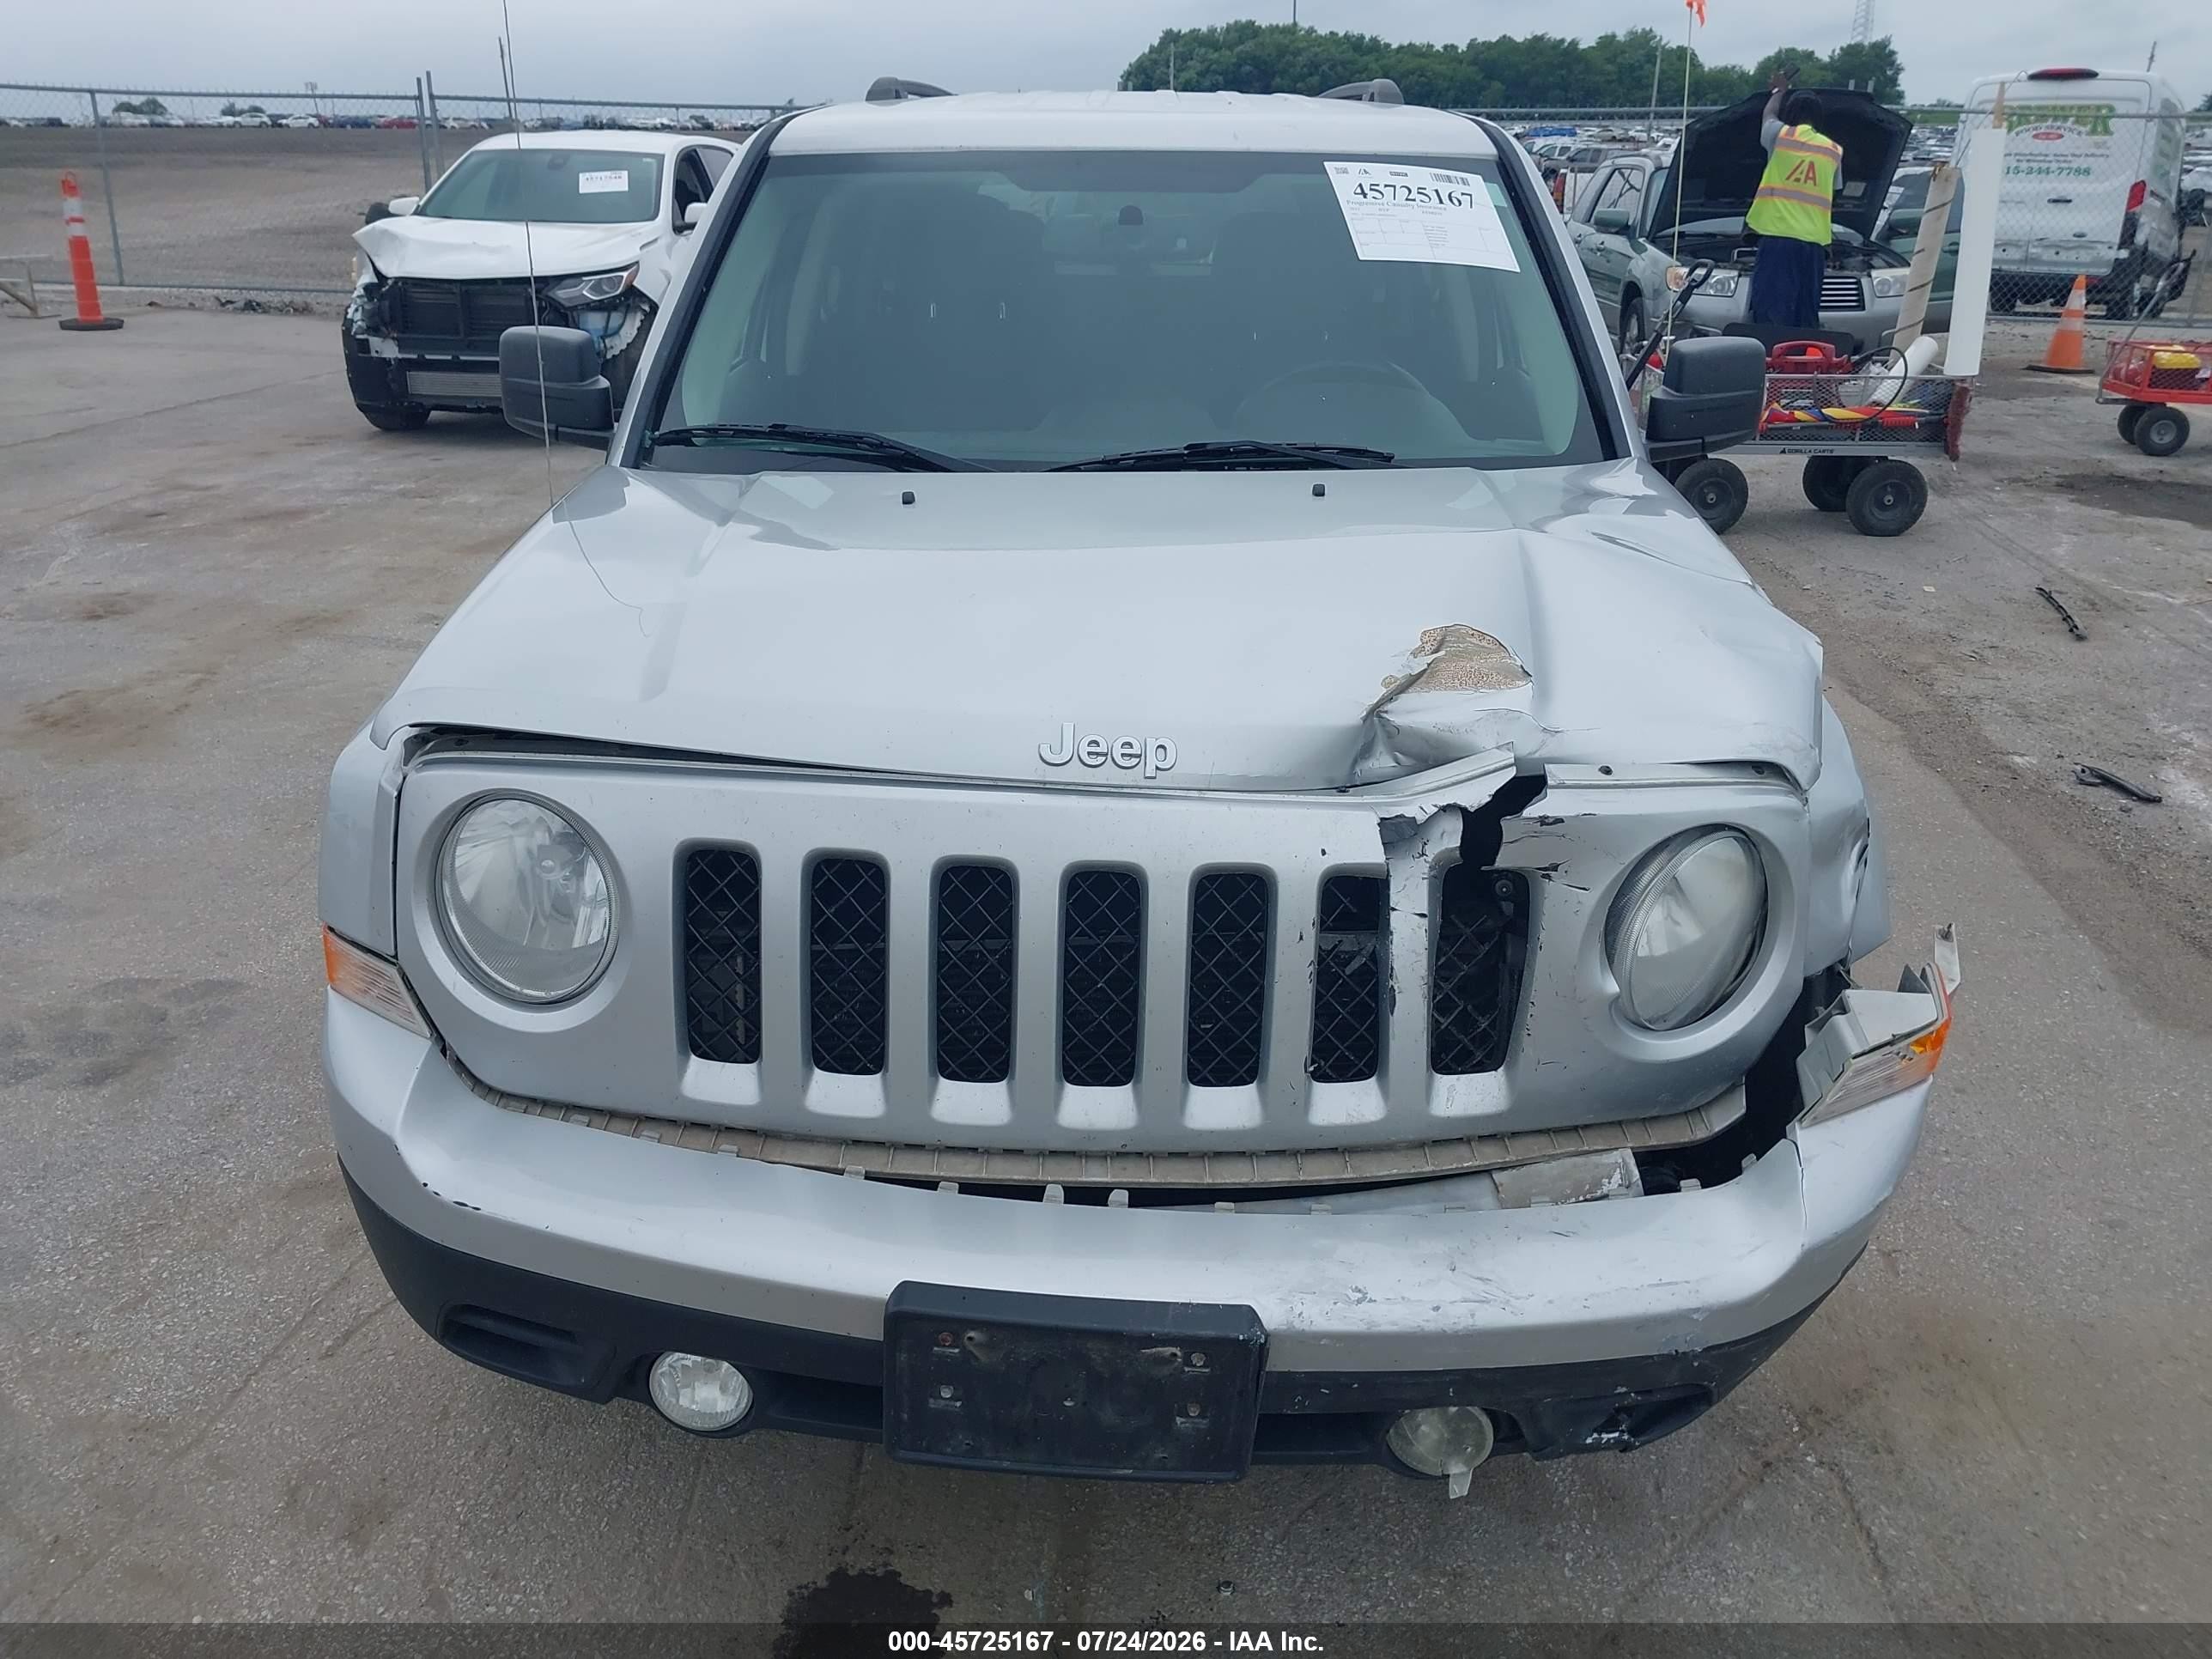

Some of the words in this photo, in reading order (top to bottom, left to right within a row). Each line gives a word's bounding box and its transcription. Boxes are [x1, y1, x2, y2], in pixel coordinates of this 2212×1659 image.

[2005, 166, 2091, 176] 15-244-7788
[1353, 182, 1474, 209] 45725167
[1038, 722, 1177, 779] Jeep
